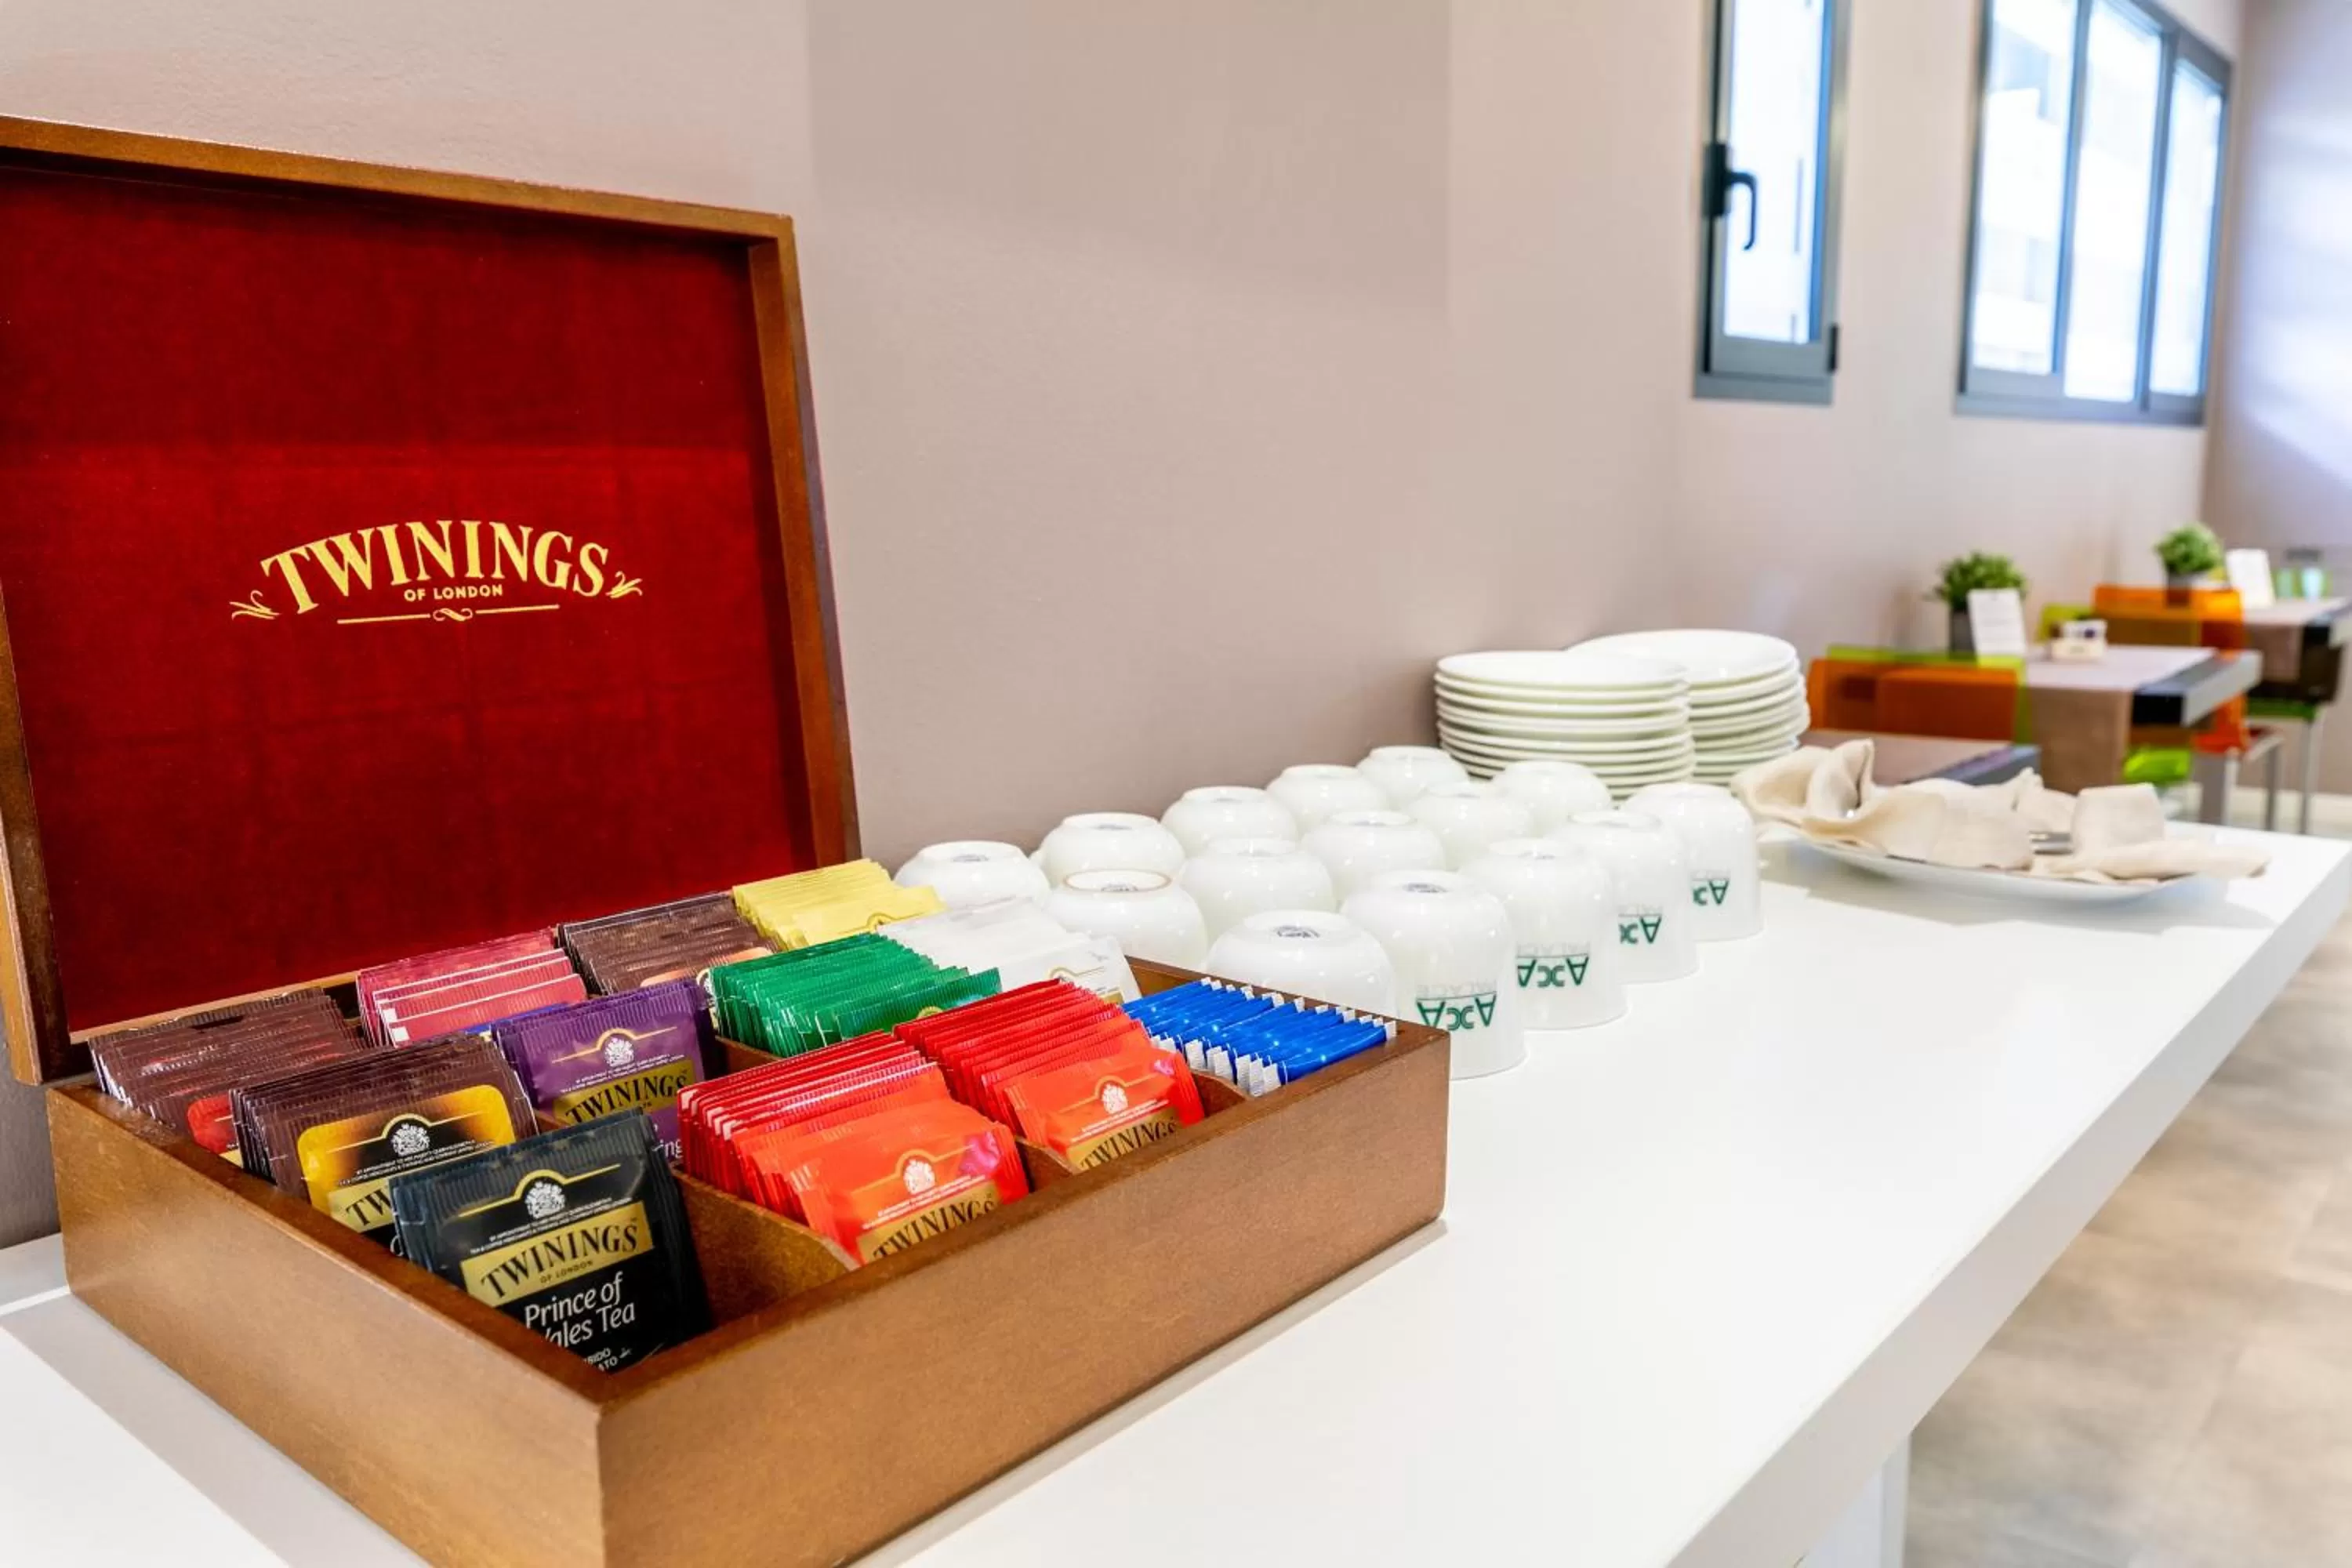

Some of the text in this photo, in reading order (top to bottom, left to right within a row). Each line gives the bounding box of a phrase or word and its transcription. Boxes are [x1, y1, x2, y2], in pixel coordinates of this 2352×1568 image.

[260, 519, 609, 615] TWININGS
[403, 583, 503, 602] OF LONDON
[481, 1222, 639, 1299] TWININGS
[524, 1270, 624, 1329] Prince of
[545, 1301, 636, 1348] ales Tea
